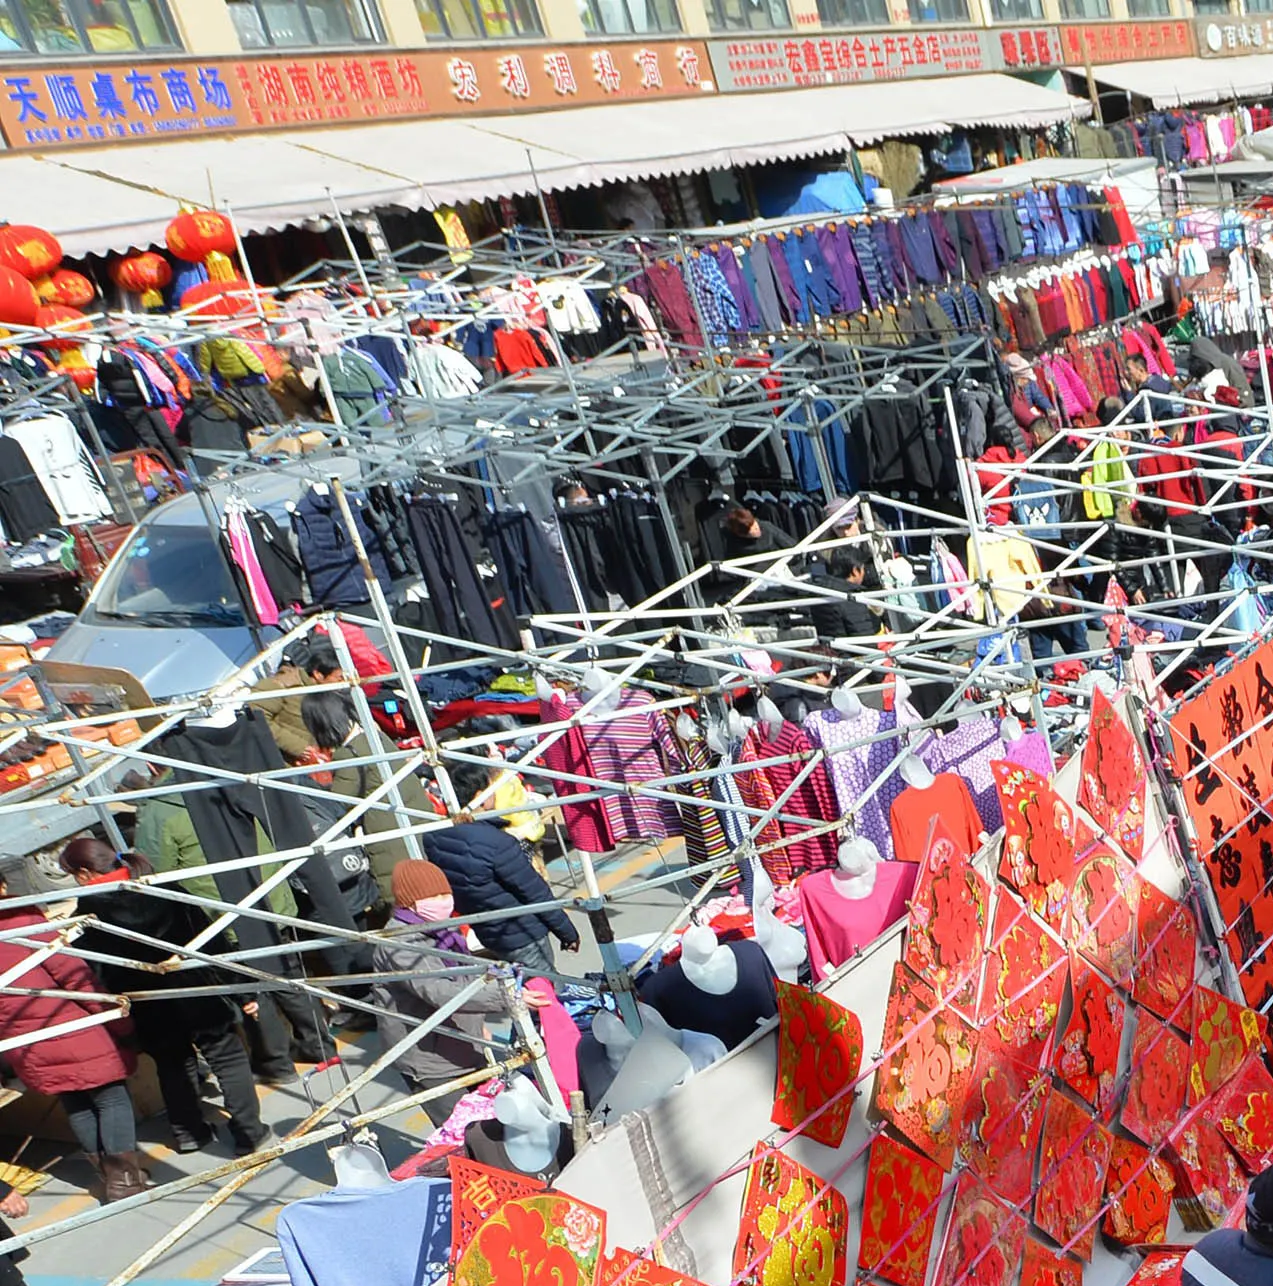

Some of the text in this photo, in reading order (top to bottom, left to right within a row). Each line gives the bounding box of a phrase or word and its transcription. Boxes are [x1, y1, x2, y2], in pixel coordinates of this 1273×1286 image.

[447, 46, 701, 101] 宏利调料商行
[784, 33, 942, 73] 宏鑫宝综合土产五金店
[4, 66, 234, 125] 天顺桌布商场
[256, 56, 424, 108] 湖南纯粮酒坊
[460, 1178, 498, 1212] 吉
